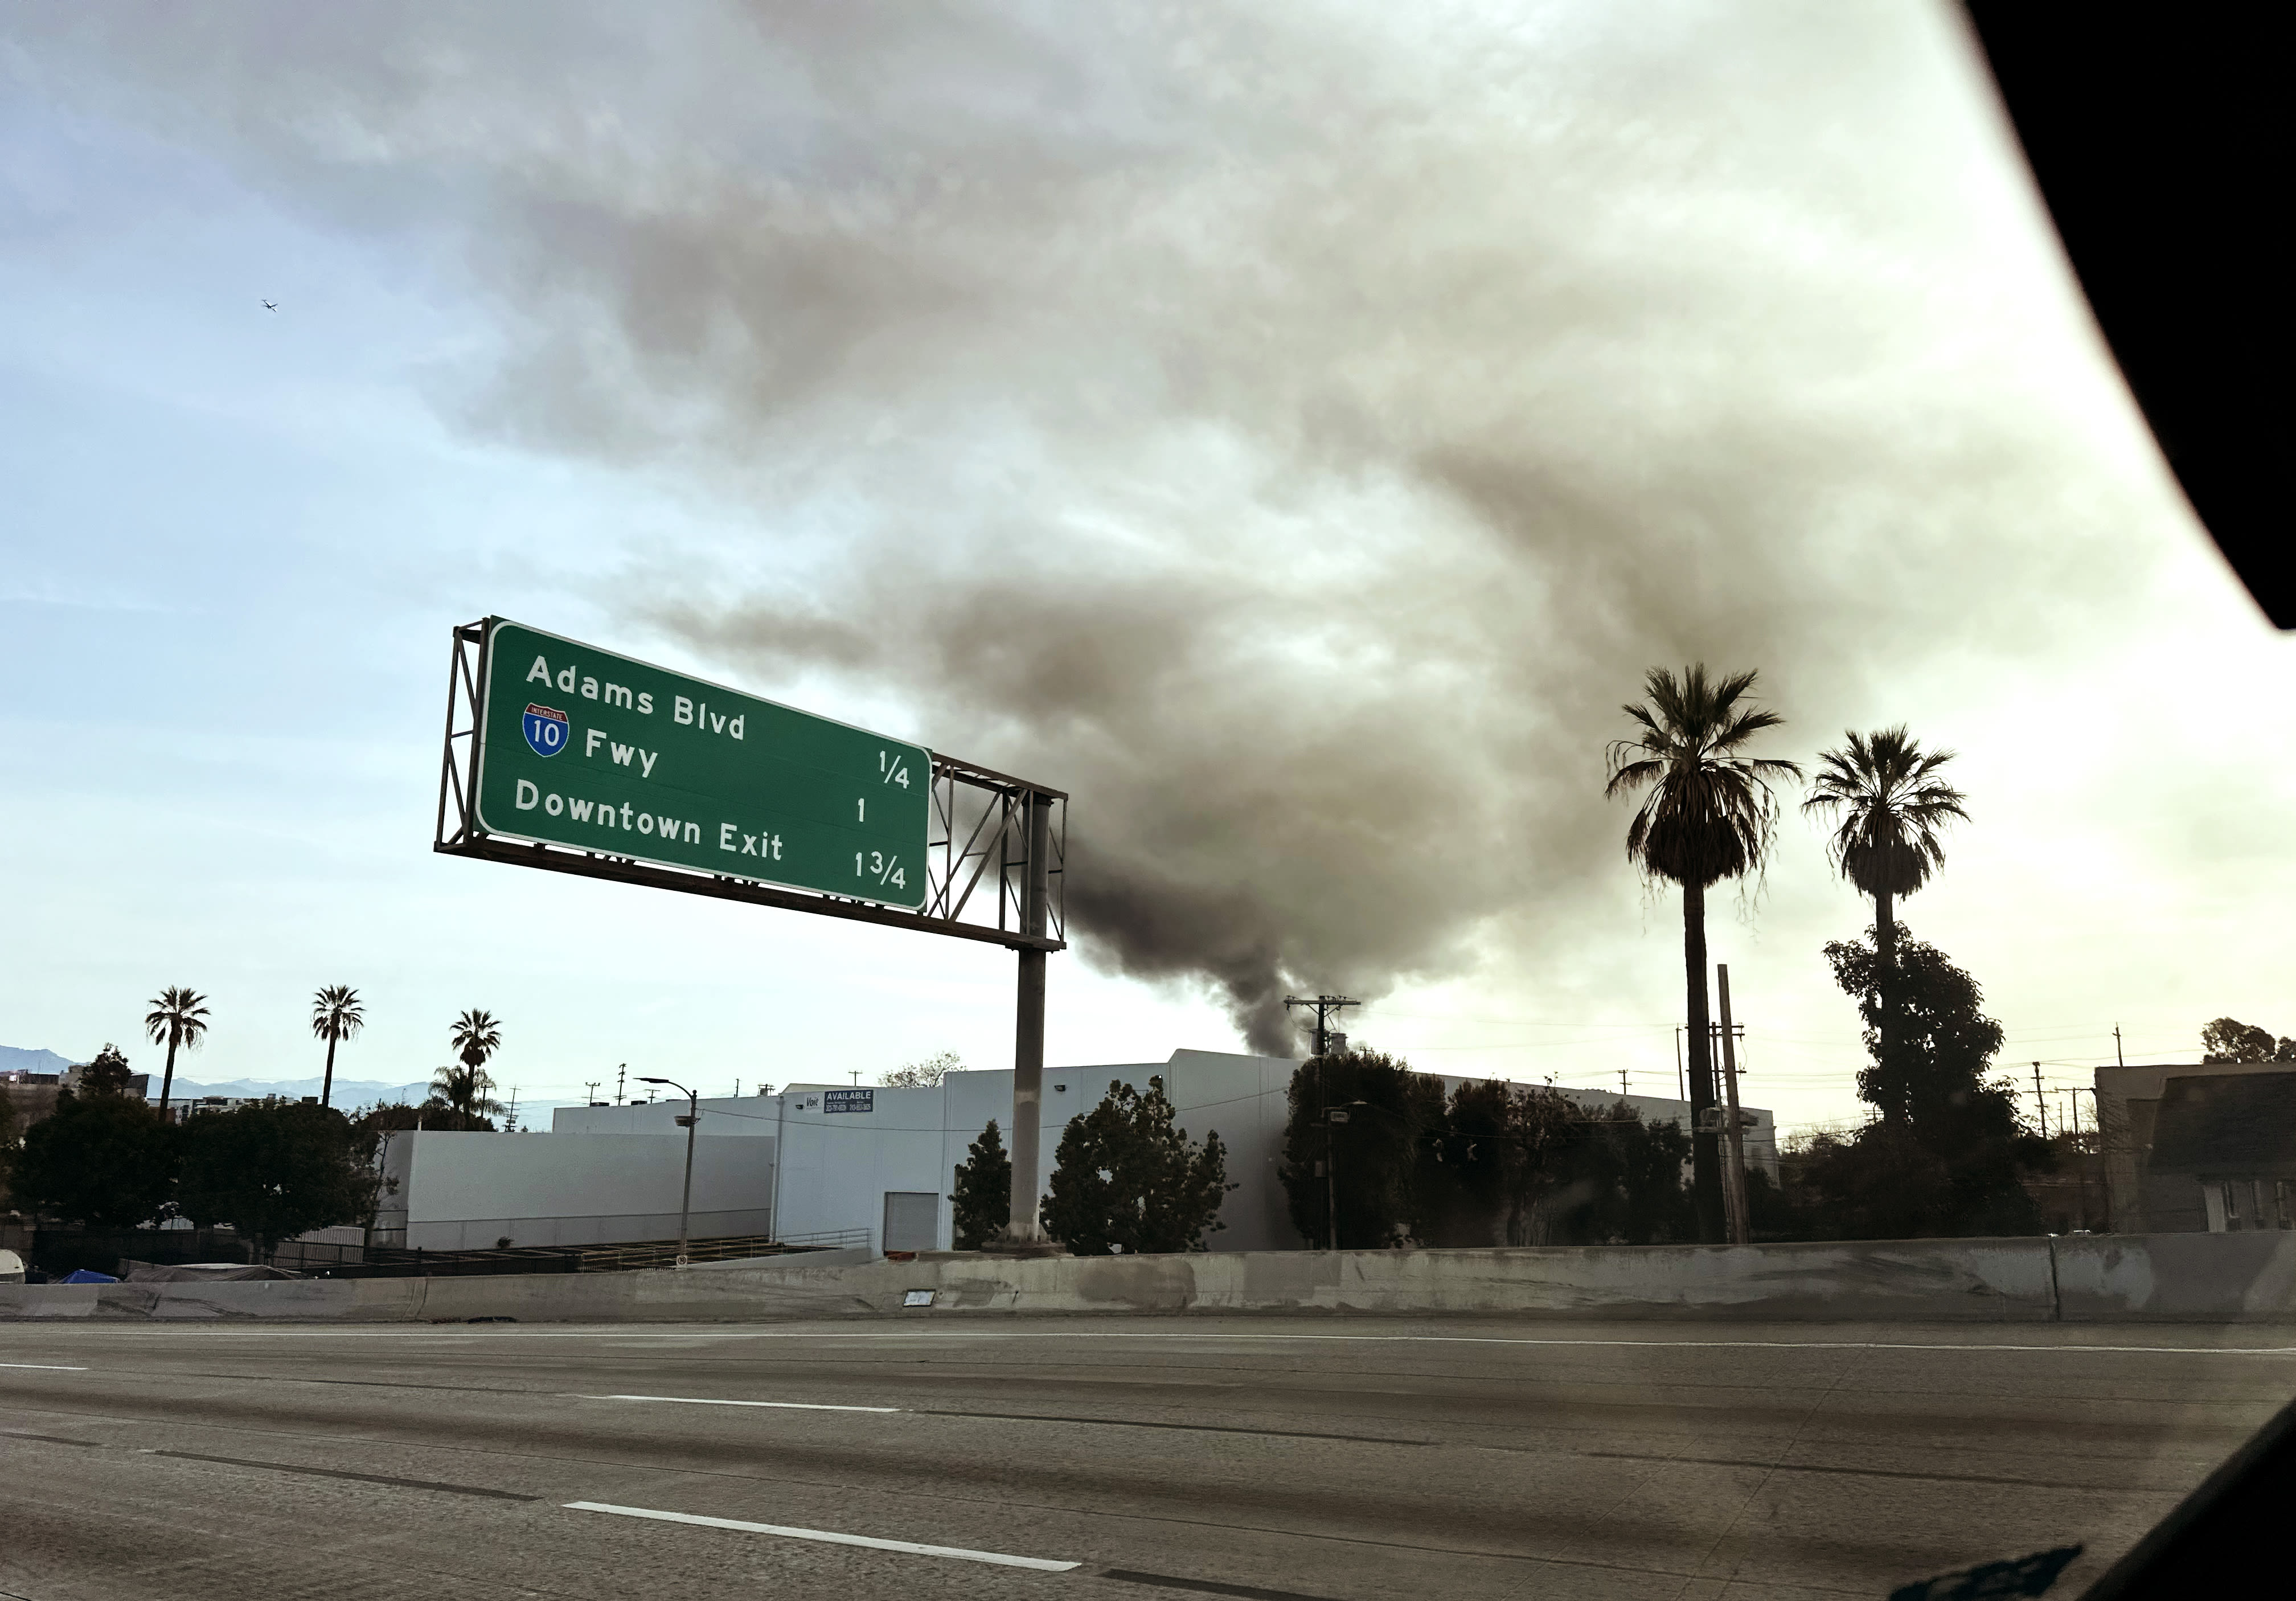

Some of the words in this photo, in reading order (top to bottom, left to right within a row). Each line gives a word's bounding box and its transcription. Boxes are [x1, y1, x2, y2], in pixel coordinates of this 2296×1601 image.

[526, 655, 654, 715] Adams
[674, 695, 745, 741] Blvd
[531, 706, 563, 720] INTERSTATE
[534, 719, 559, 747] 10
[585, 728, 658, 778] Fwy
[880, 750, 909, 789] 1/4
[515, 779, 701, 845] Downtown
[719, 822, 783, 861] Exit
[858, 798, 864, 822] 1
[806, 1097, 819, 1107] Voit
[826, 1091, 871, 1101] AVAILABLE
